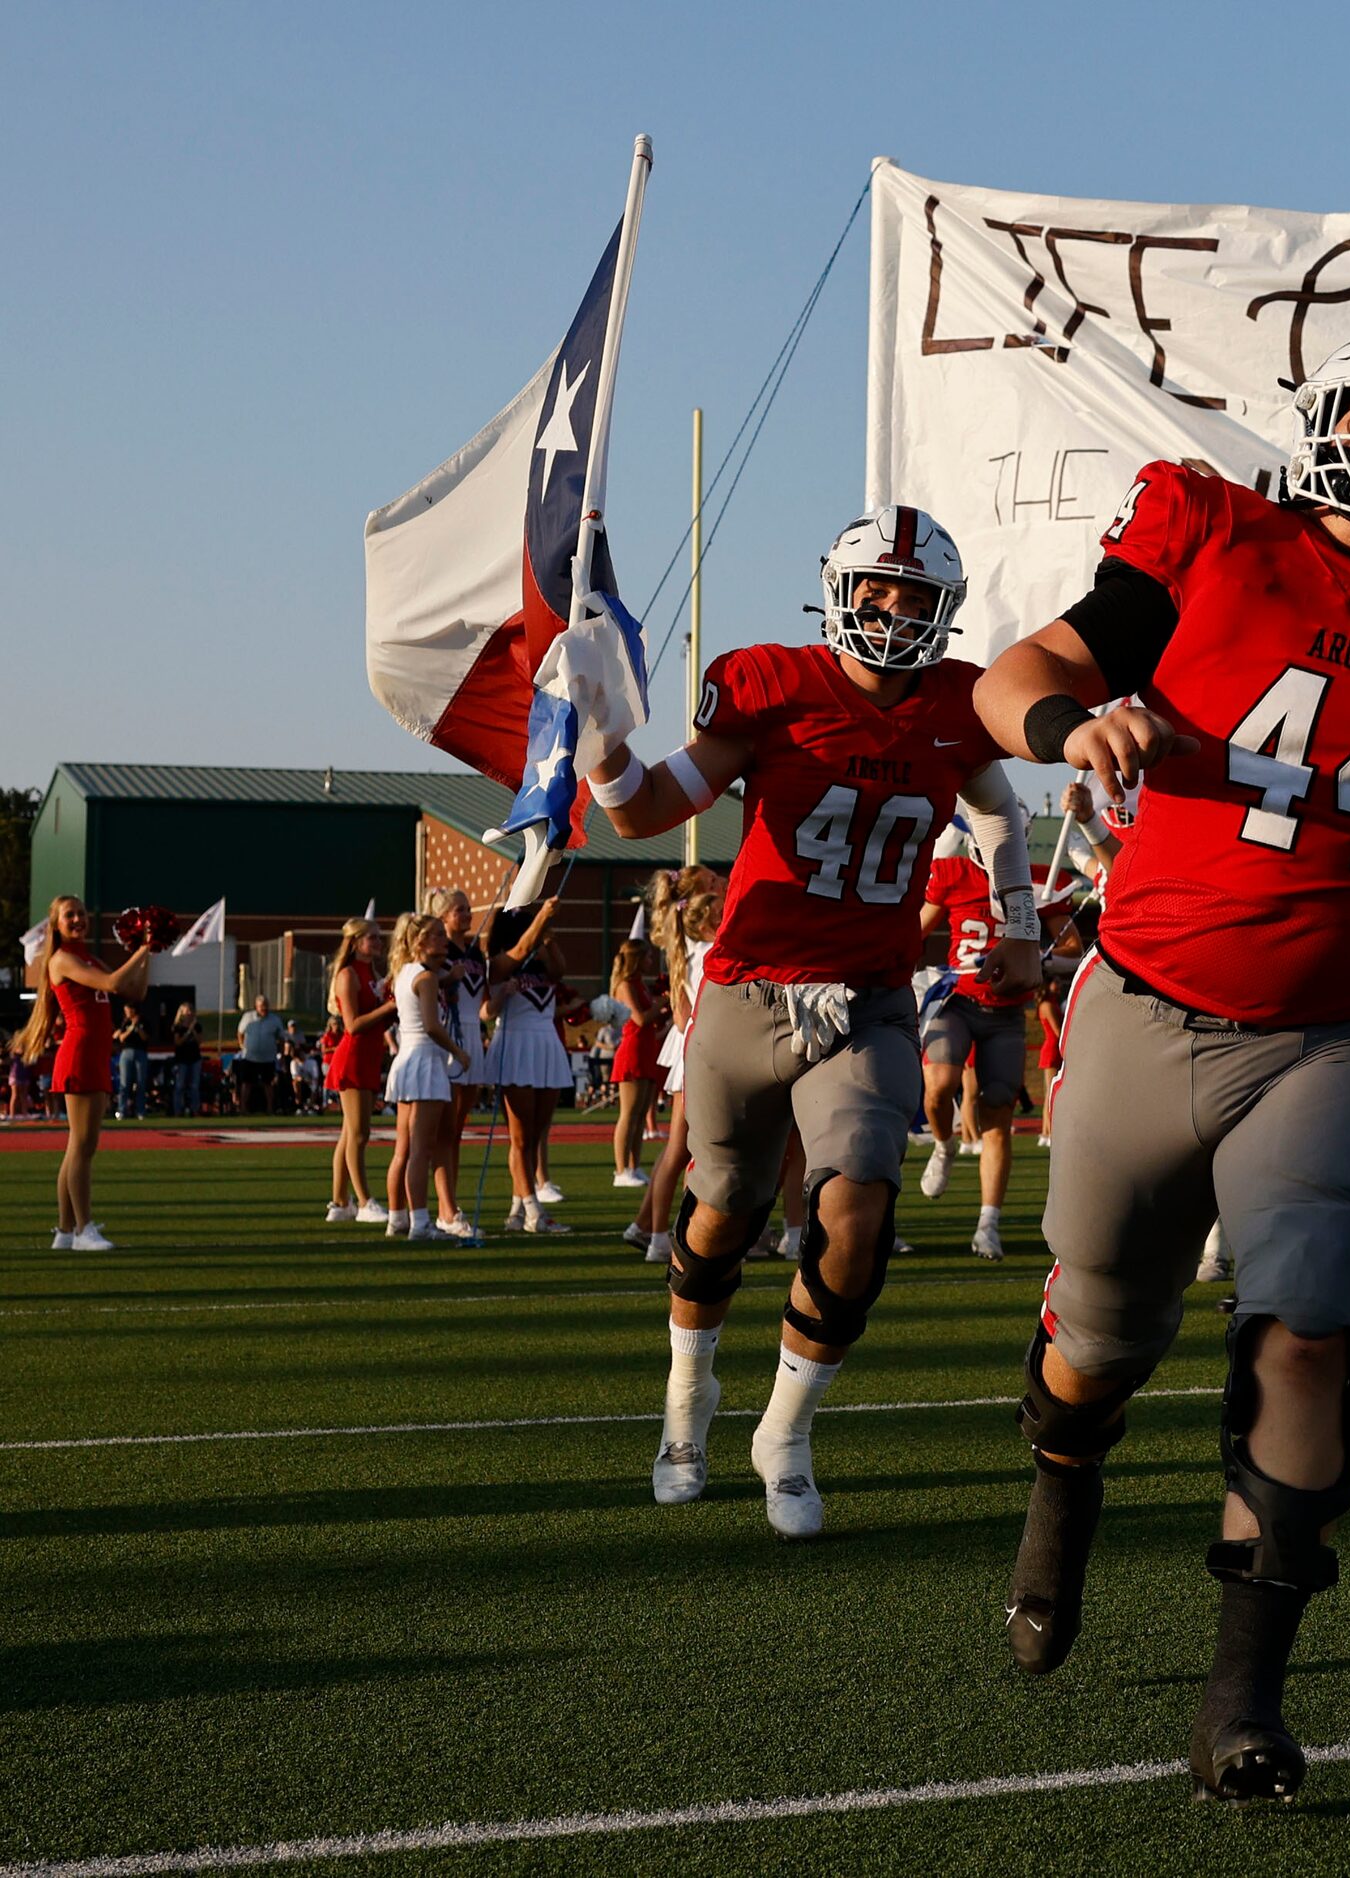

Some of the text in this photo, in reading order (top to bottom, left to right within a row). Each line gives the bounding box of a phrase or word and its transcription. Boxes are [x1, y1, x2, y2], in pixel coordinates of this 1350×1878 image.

[988, 449, 1110, 524] THE
[844, 754, 912, 785] ARGYLE
[795, 783, 935, 905] 40
[1009, 905, 1021, 925] 8:18
[1022, 892, 1036, 936] ROMANS
